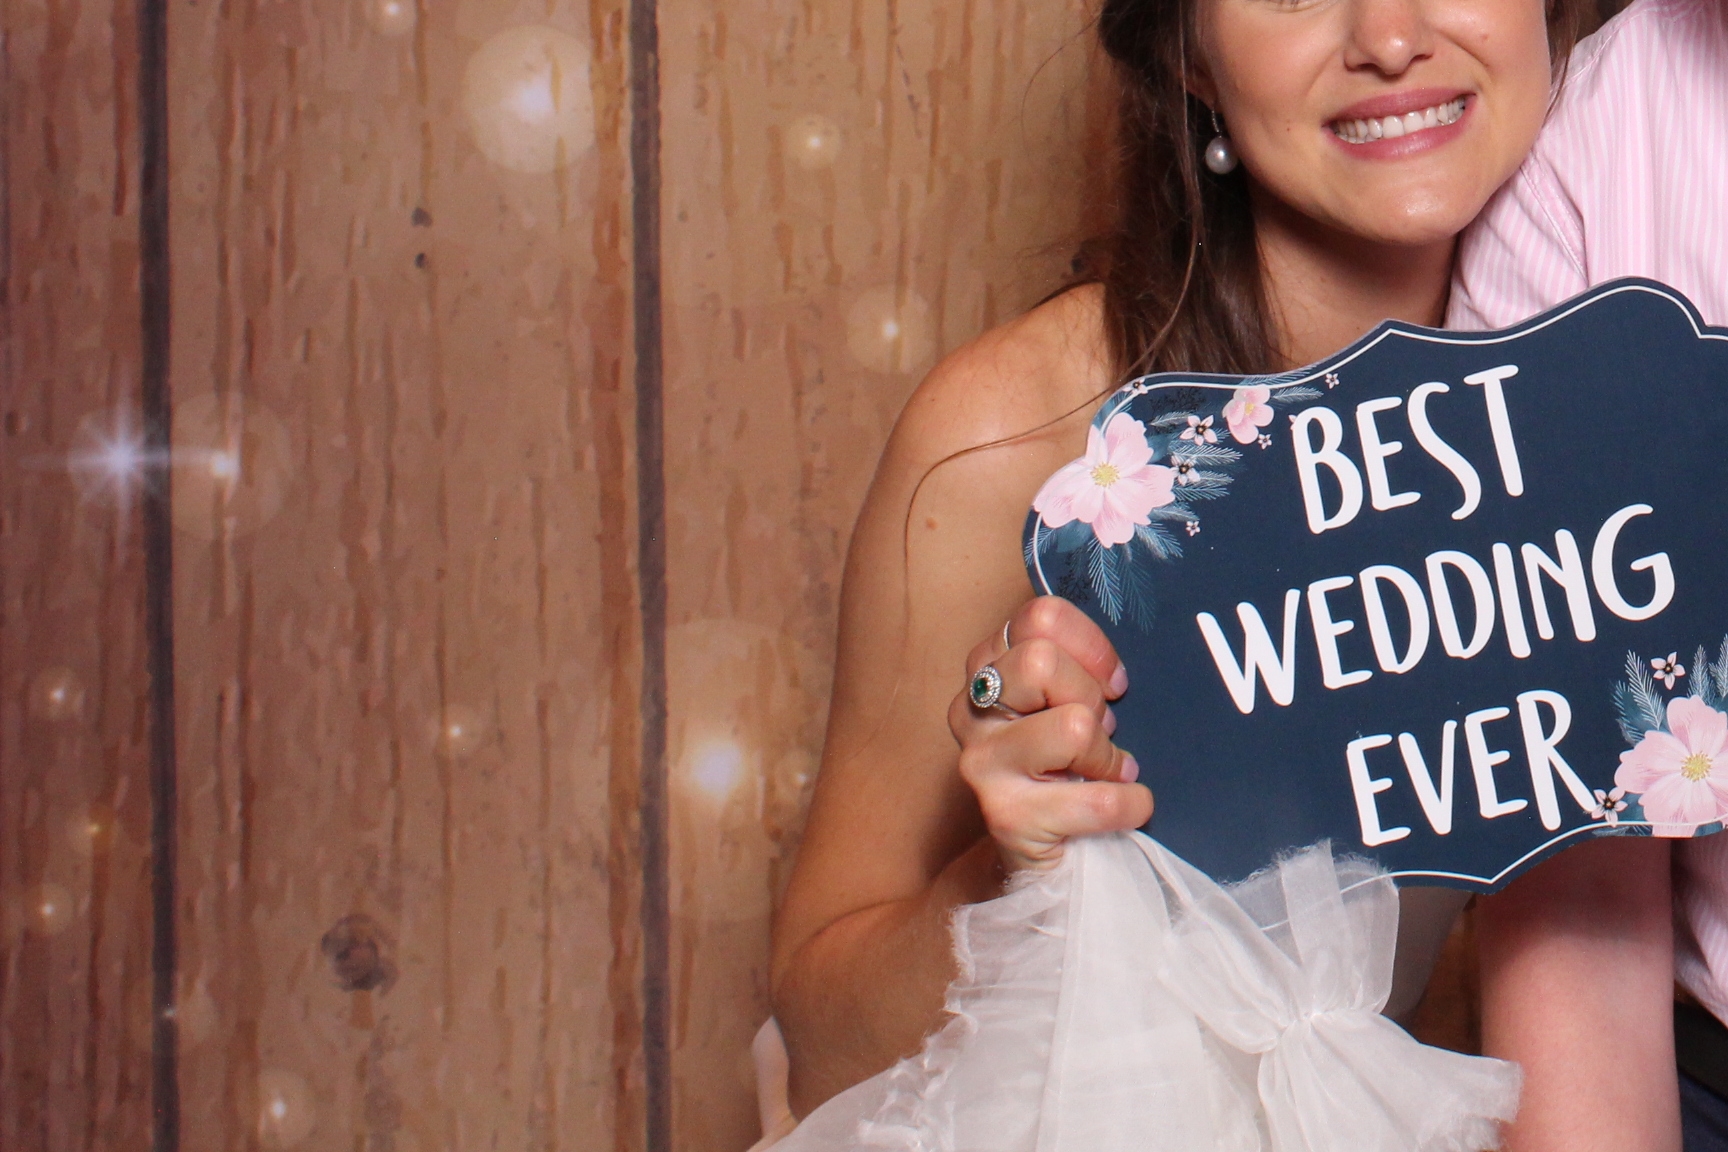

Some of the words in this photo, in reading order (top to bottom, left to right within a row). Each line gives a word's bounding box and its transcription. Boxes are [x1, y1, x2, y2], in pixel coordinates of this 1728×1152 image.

[1292, 363, 1525, 534] BEST
[1196, 503, 1676, 714] WEDDING
[1346, 689, 1600, 847] EVER
